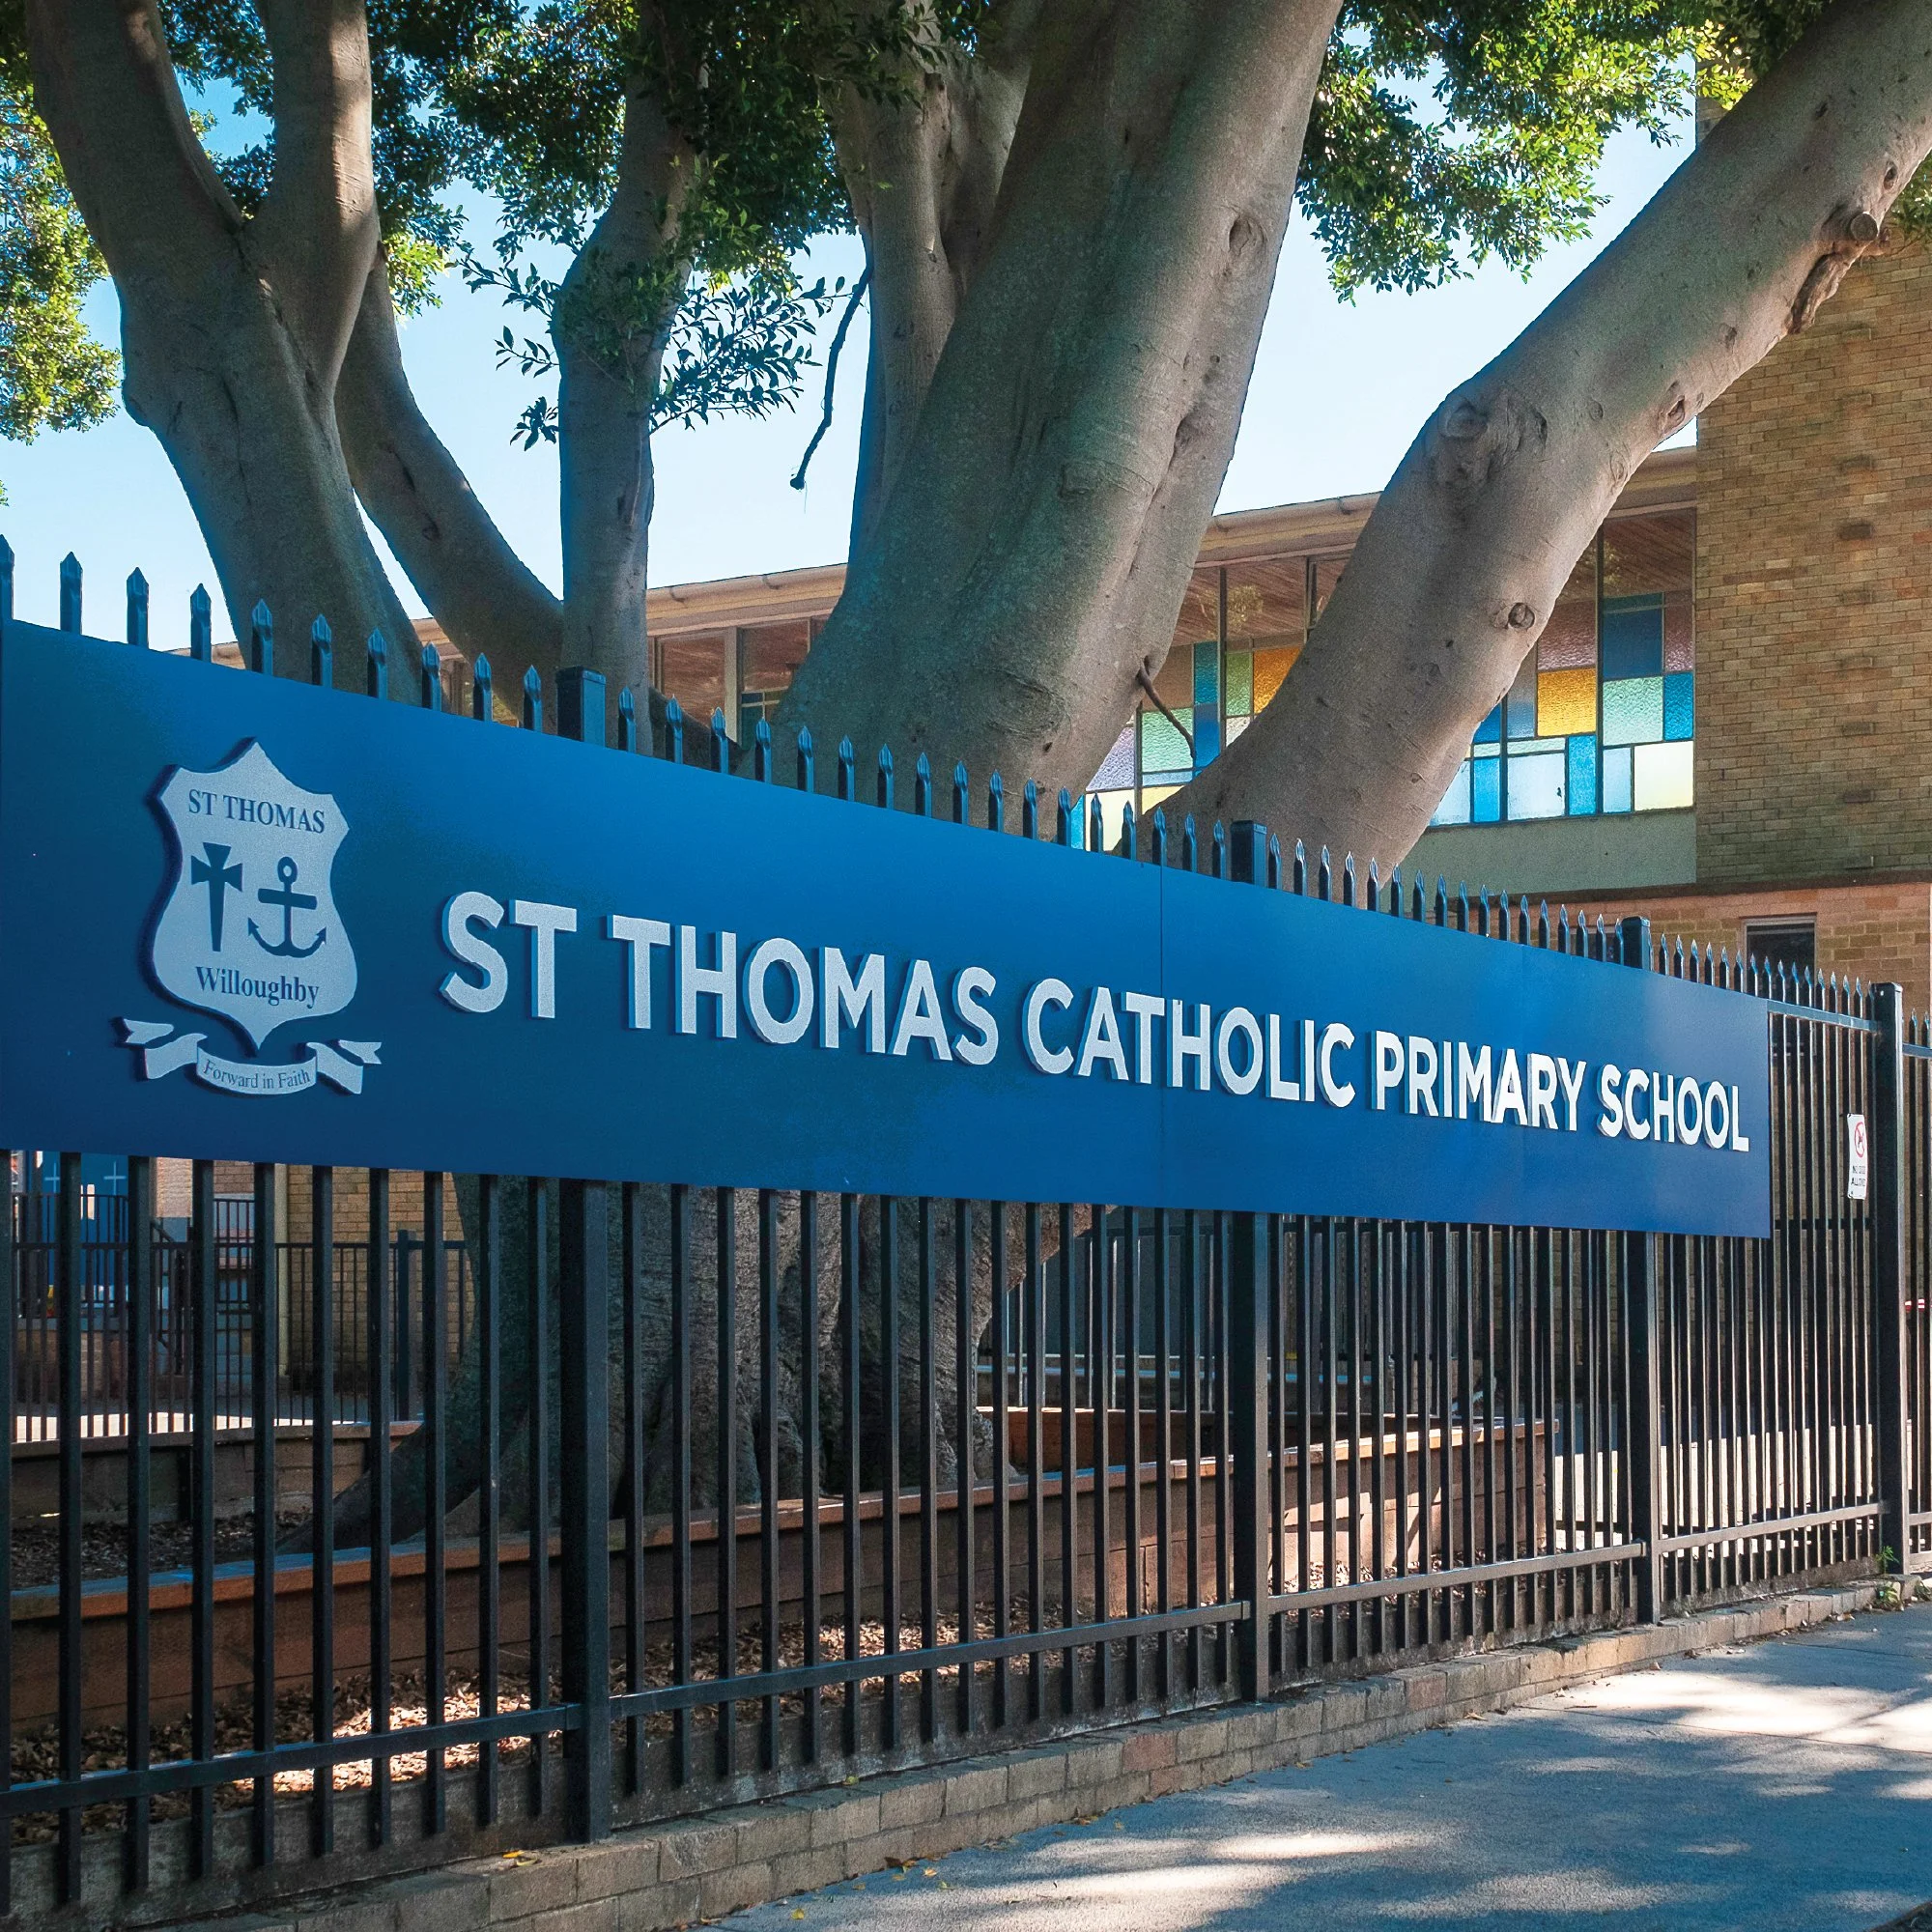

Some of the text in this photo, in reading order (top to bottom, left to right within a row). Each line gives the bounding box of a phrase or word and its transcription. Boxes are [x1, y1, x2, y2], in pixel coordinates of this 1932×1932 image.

[187, 788, 326, 835] ST THOMAS
[195, 966, 320, 1008] Willoughby
[439, 891, 1750, 1152] ST THOMAS CATHOLIC PRIMARY SCHOOL
[203, 1059, 310, 1090] Forward in Faith
